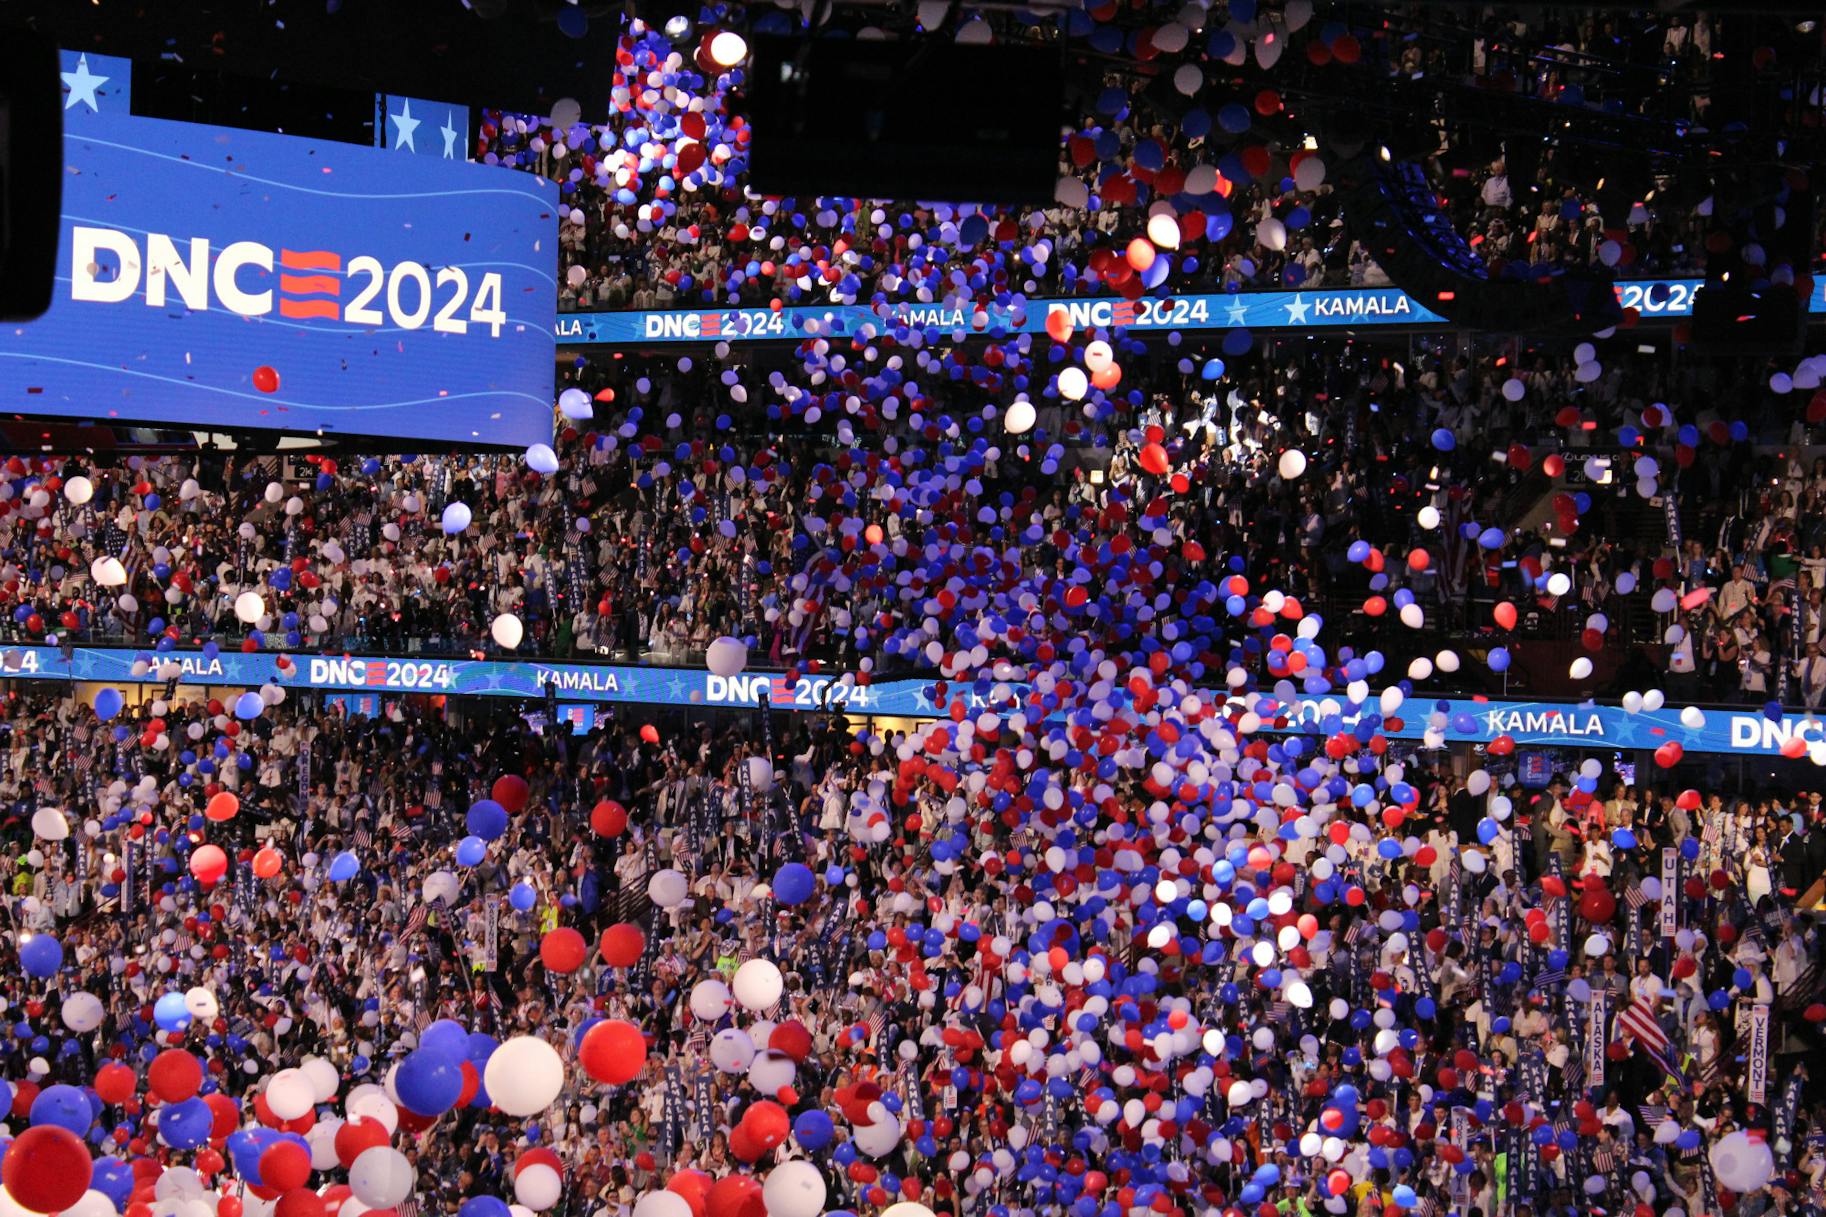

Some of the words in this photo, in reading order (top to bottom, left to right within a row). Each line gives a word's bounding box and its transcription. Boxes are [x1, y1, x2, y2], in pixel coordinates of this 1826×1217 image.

[71, 226, 274, 316] DNC
[345, 255, 506, 338] 2024
[646, 314, 700, 338] DNC
[1136, 299, 1209, 325] 2024
[1314, 295, 1410, 316] KAMALA
[1666, 495, 1678, 541] KAMALA
[148, 655, 223, 675] AALA
[310, 659, 366, 685] DNC
[387, 663, 449, 688] 2024
[537, 669, 619, 691] KAMALA
[707, 674, 770, 703] DNC
[1488, 711, 1604, 735] KAMALA
[1731, 716, 1826, 748] DNC
[742, 765, 750, 808] KAMALA
[788, 805, 802, 845] KAMALA
[1450, 884, 1458, 926] AMALA
[1664, 858, 1674, 924] UTAH
[1559, 901, 1567, 952] KAMALA
[1413, 951, 1432, 998] KAMALA
[1482, 955, 1491, 1008] KAMALA
[1538, 955, 1548, 1008] KALA
[1565, 995, 1579, 1035] AMALA
[1593, 1003, 1604, 1072] ALASKA
[1752, 1017, 1765, 1089] VERMONT
[668, 1072, 684, 1121] KAMALA
[700, 1082, 710, 1131] KAMALA
[908, 1072, 919, 1116] KAMAL
[1775, 1107, 1788, 1163] KAMA
[1510, 1136, 1519, 1195] KAMALA
